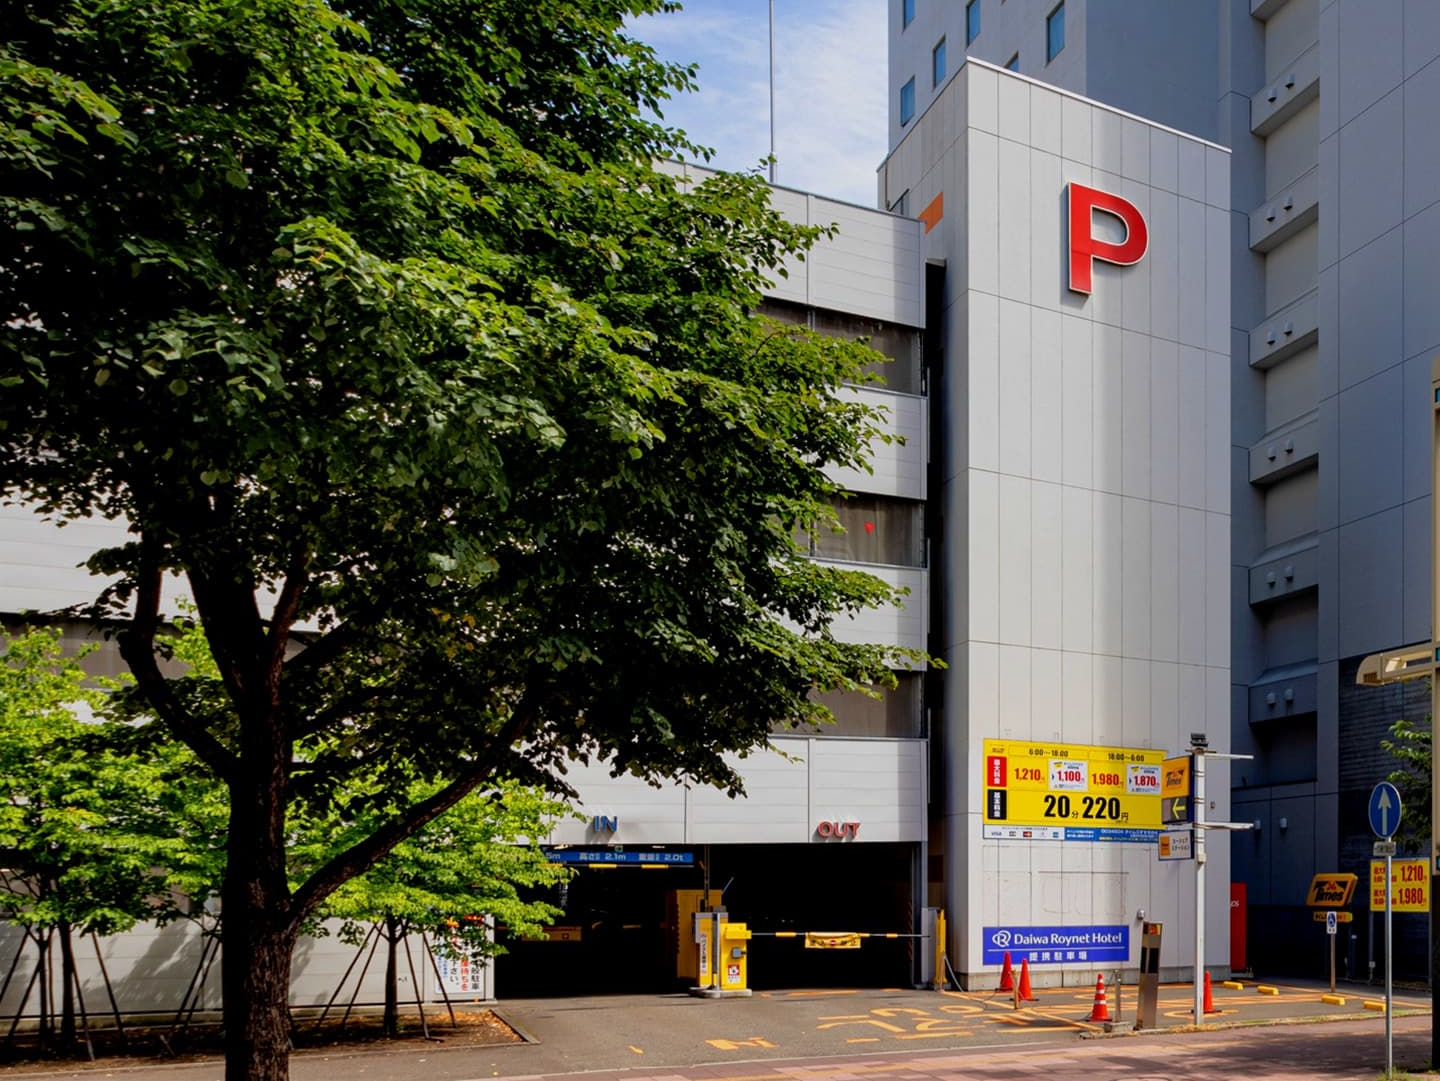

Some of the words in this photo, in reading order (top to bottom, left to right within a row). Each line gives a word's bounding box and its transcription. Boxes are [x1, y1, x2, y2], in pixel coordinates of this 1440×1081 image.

[1067, 181, 1149, 295] P
[593, 815, 619, 832] IN
[817, 820, 861, 839] OUT
[1314, 881, 1347, 902] Times
[1014, 933, 1049, 945] Daiwa
[1050, 932, 1090, 947] Roynet
[1092, 931, 1122, 944] Hotel
